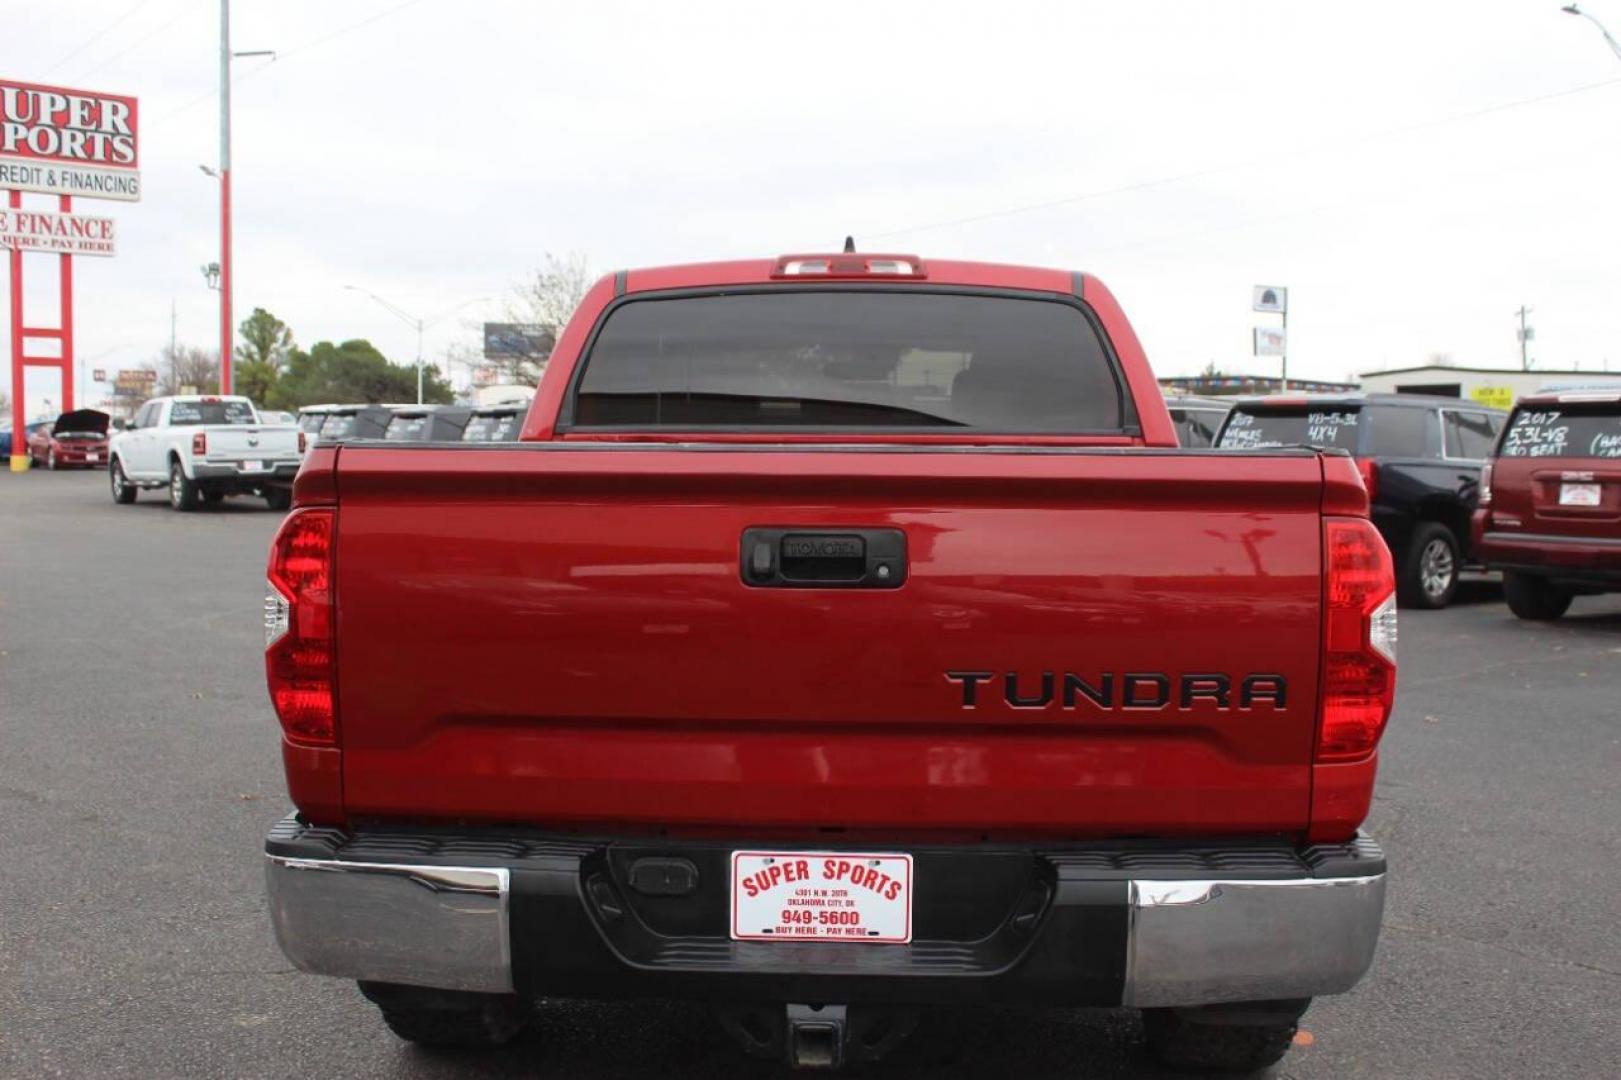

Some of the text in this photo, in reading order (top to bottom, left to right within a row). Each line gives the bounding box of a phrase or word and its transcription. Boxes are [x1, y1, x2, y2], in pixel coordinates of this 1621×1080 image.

[46, 168, 57, 187] &
[61, 170, 138, 195] FINANCING
[15, 212, 114, 240] FINANCE
[3, 234, 40, 247] HERE
[50, 238, 73, 250] PAY
[79, 241, 114, 252] HERE
[1518, 411, 1561, 425] 2017
[1308, 425, 1338, 442] 4X4
[944, 671, 1288, 711] TUNDRA
[742, 859, 902, 900] SUPER SPORTS
[787, 898, 825, 906] OKLAHOMA
[781, 910, 859, 925] 949-5600
[775, 926, 792, 934] BUY
[795, 926, 817, 934] HERE
[826, 927, 842, 935] PAY
[845, 927, 867, 936] HERE
